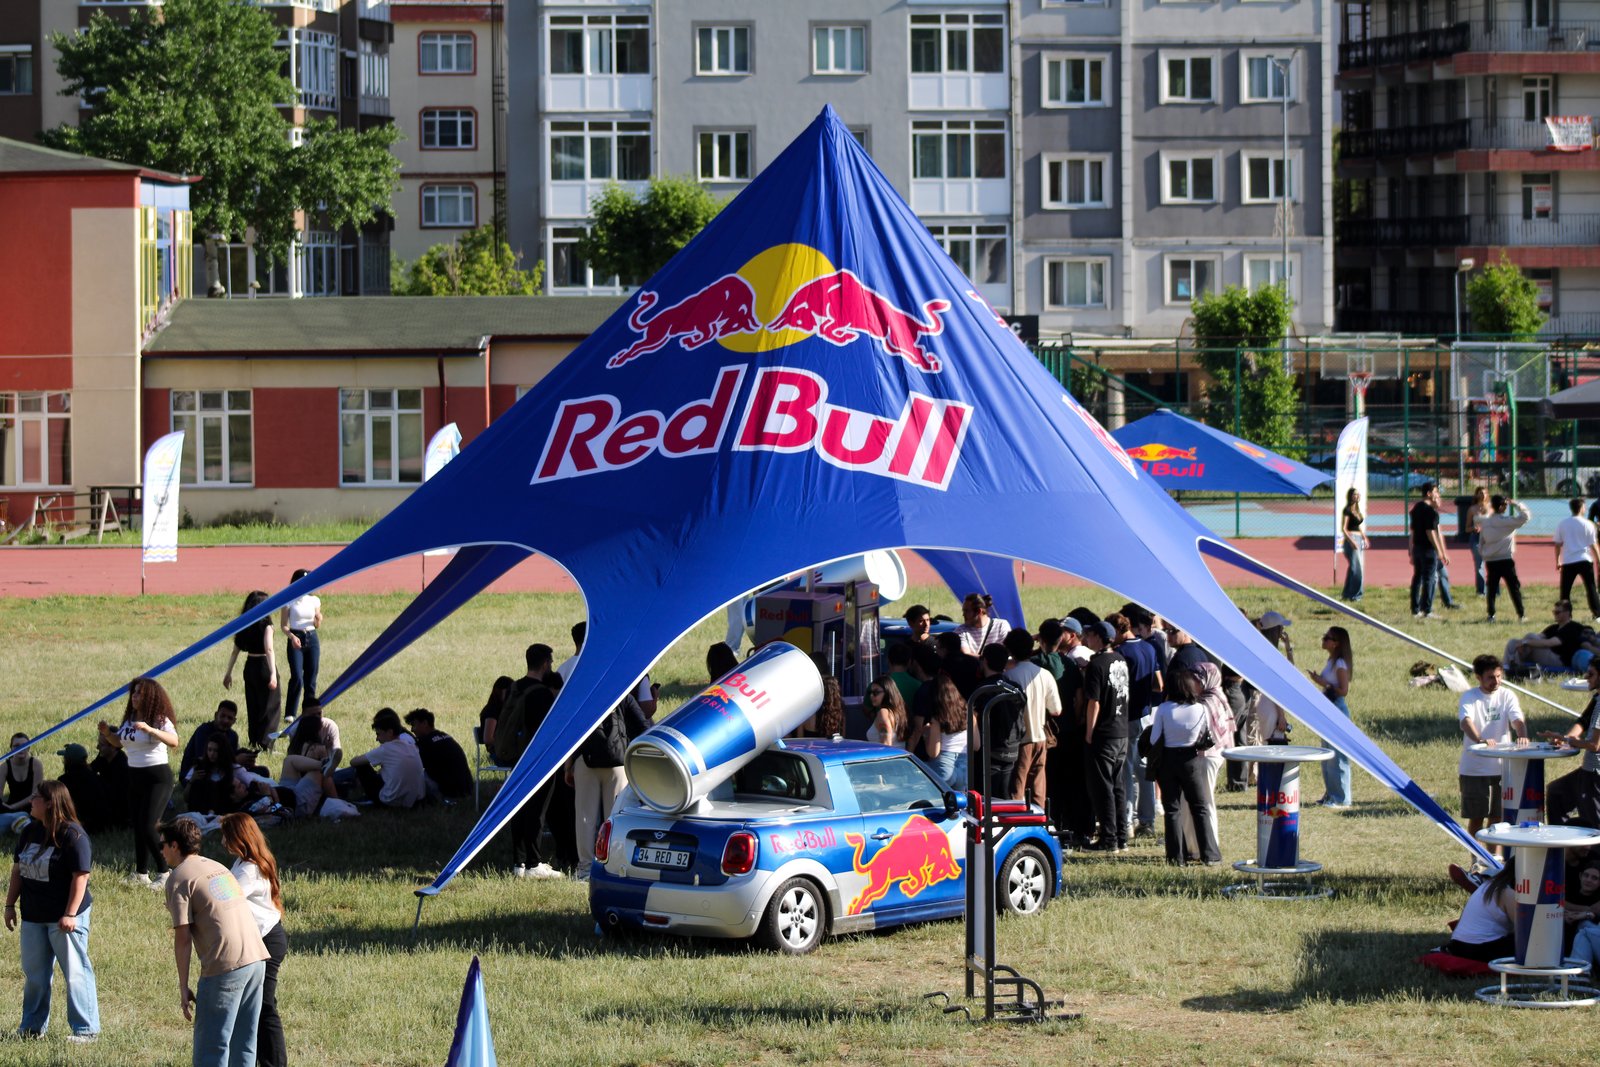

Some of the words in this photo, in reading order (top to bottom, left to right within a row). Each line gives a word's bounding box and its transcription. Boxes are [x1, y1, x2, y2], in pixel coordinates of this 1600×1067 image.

[533, 366, 745, 482] Red
[736, 368, 970, 488] Bull
[1152, 463, 1205, 477] Bull
[759, 607, 784, 620] Red
[723, 673, 771, 710] Bull
[1277, 790, 1298, 804] Bull
[804, 826, 837, 849] Bull
[638, 848, 649, 862] 34
[654, 850, 671, 864] RED
[676, 852, 688, 866] 92
[1516, 879, 1530, 895] ull
[1545, 880, 1565, 895] Re
